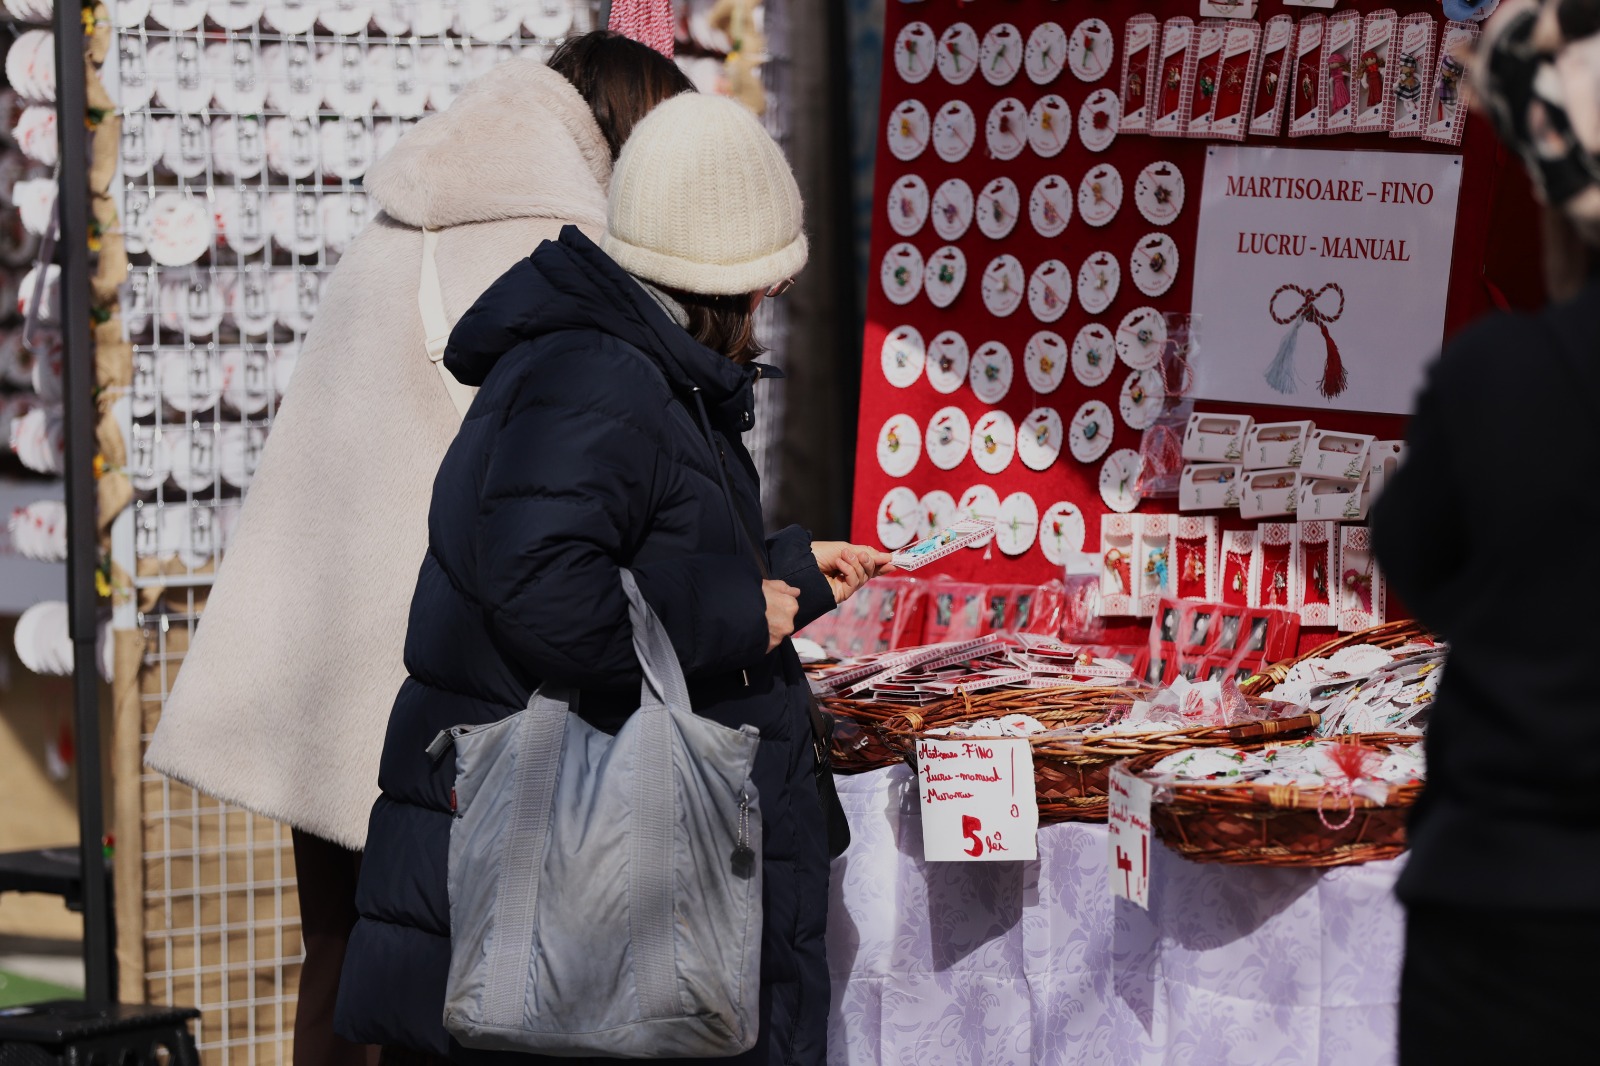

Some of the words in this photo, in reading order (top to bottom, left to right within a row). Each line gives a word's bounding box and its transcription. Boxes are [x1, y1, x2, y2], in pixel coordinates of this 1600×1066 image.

[1225, 175, 1363, 202] MARTISOARE
[1380, 181, 1434, 205] FINO
[1237, 232, 1307, 256] LUCRU
[1320, 236, 1411, 262] MANUAL
[962, 814, 984, 857] 5
[985, 831, 1009, 853] lei
